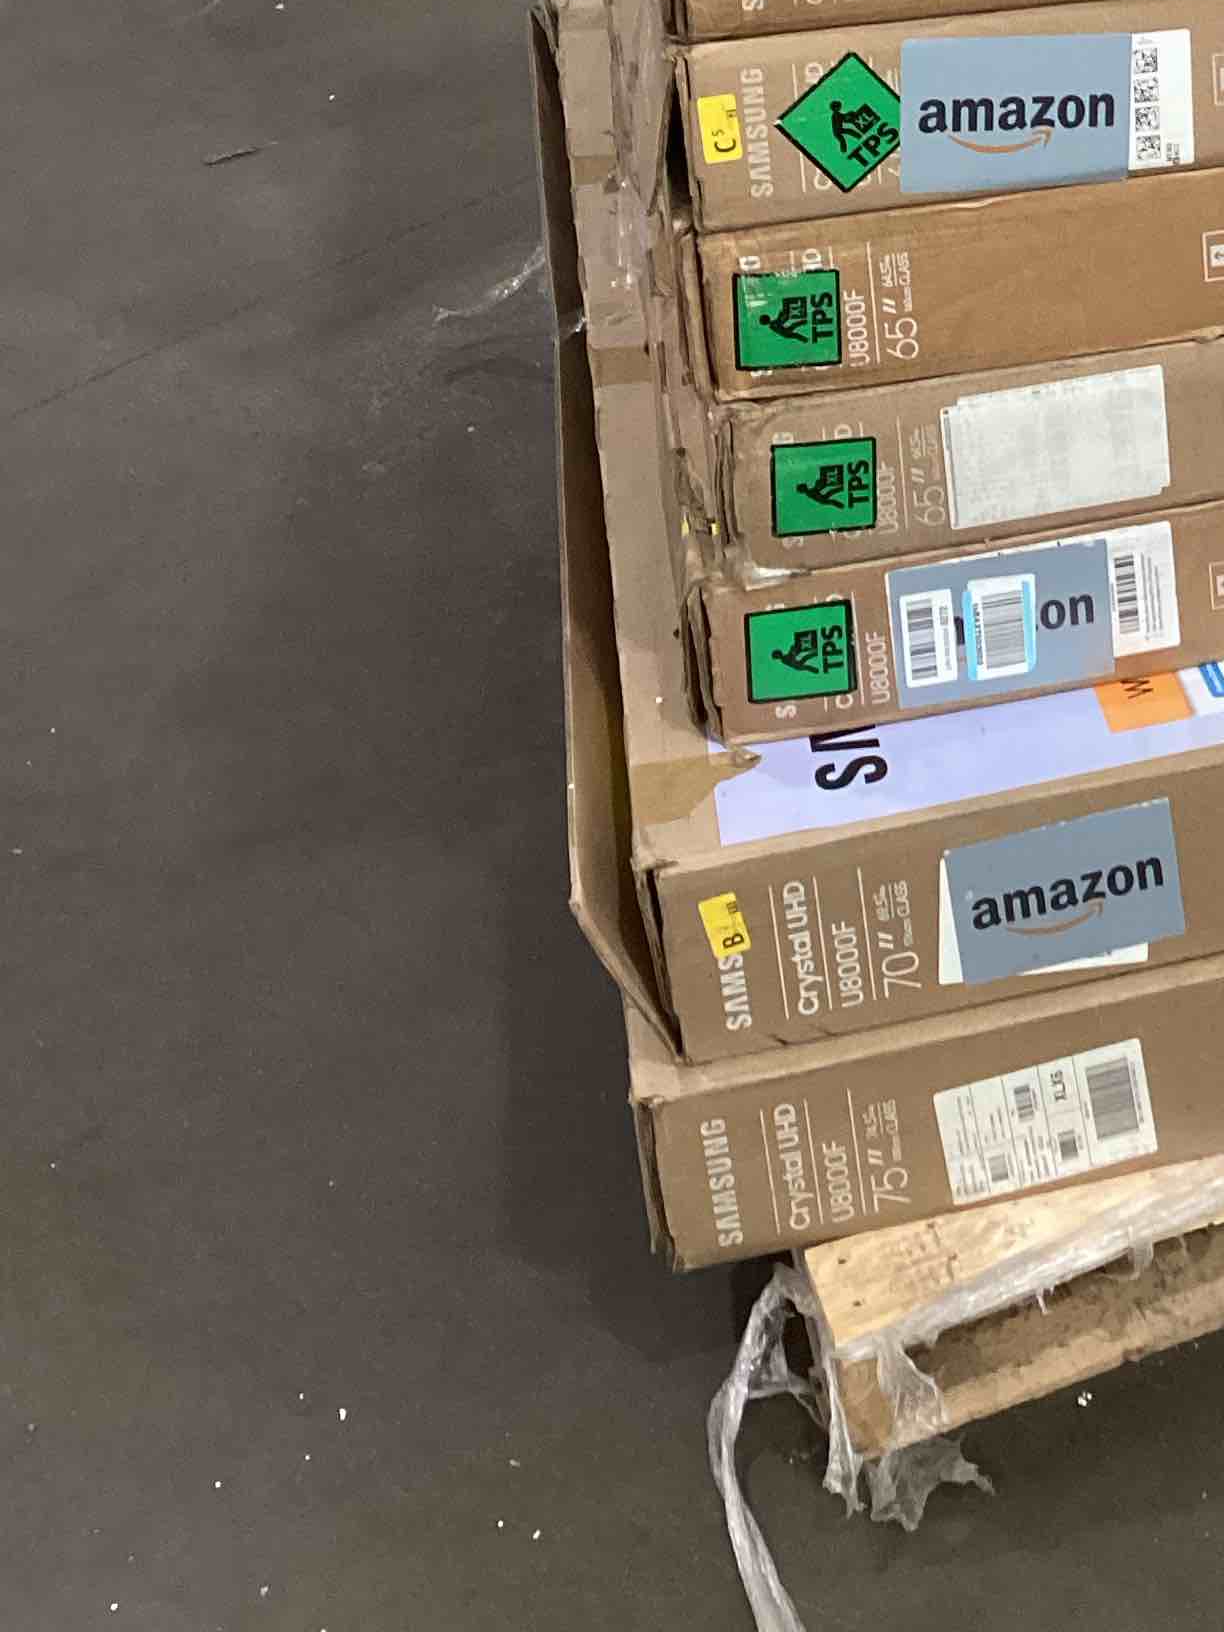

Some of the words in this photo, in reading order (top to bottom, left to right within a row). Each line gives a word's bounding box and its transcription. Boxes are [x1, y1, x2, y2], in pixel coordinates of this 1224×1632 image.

[739, 67, 774, 199] SAMSUNG
[847, 119, 899, 167] TPS
[917, 90, 1116, 134] amazon
[810, 291, 834, 345] TPS
[842, 288, 870, 366] U8000F
[881, 297, 919, 361] 65"
[847, 459, 870, 509] TPS
[820, 624, 844, 675] TPS
[865, 631, 891, 705] U8000F
[782, 880, 807, 929] UHD
[971, 855, 1165, 932] amazon
[718, 953, 752, 1031] SAMS
[787, 929, 823, 1016] Crystal
[831, 920, 865, 1008] U8000F
[877, 930, 922, 999] 70"
[773, 1103, 799, 1150] UHD
[699, 1117, 744, 1248] SAMSUNG
[778, 1149, 814, 1231] Crystal
[822, 1139, 856, 1223] U8000F
[866, 1148, 912, 1214] 75"
